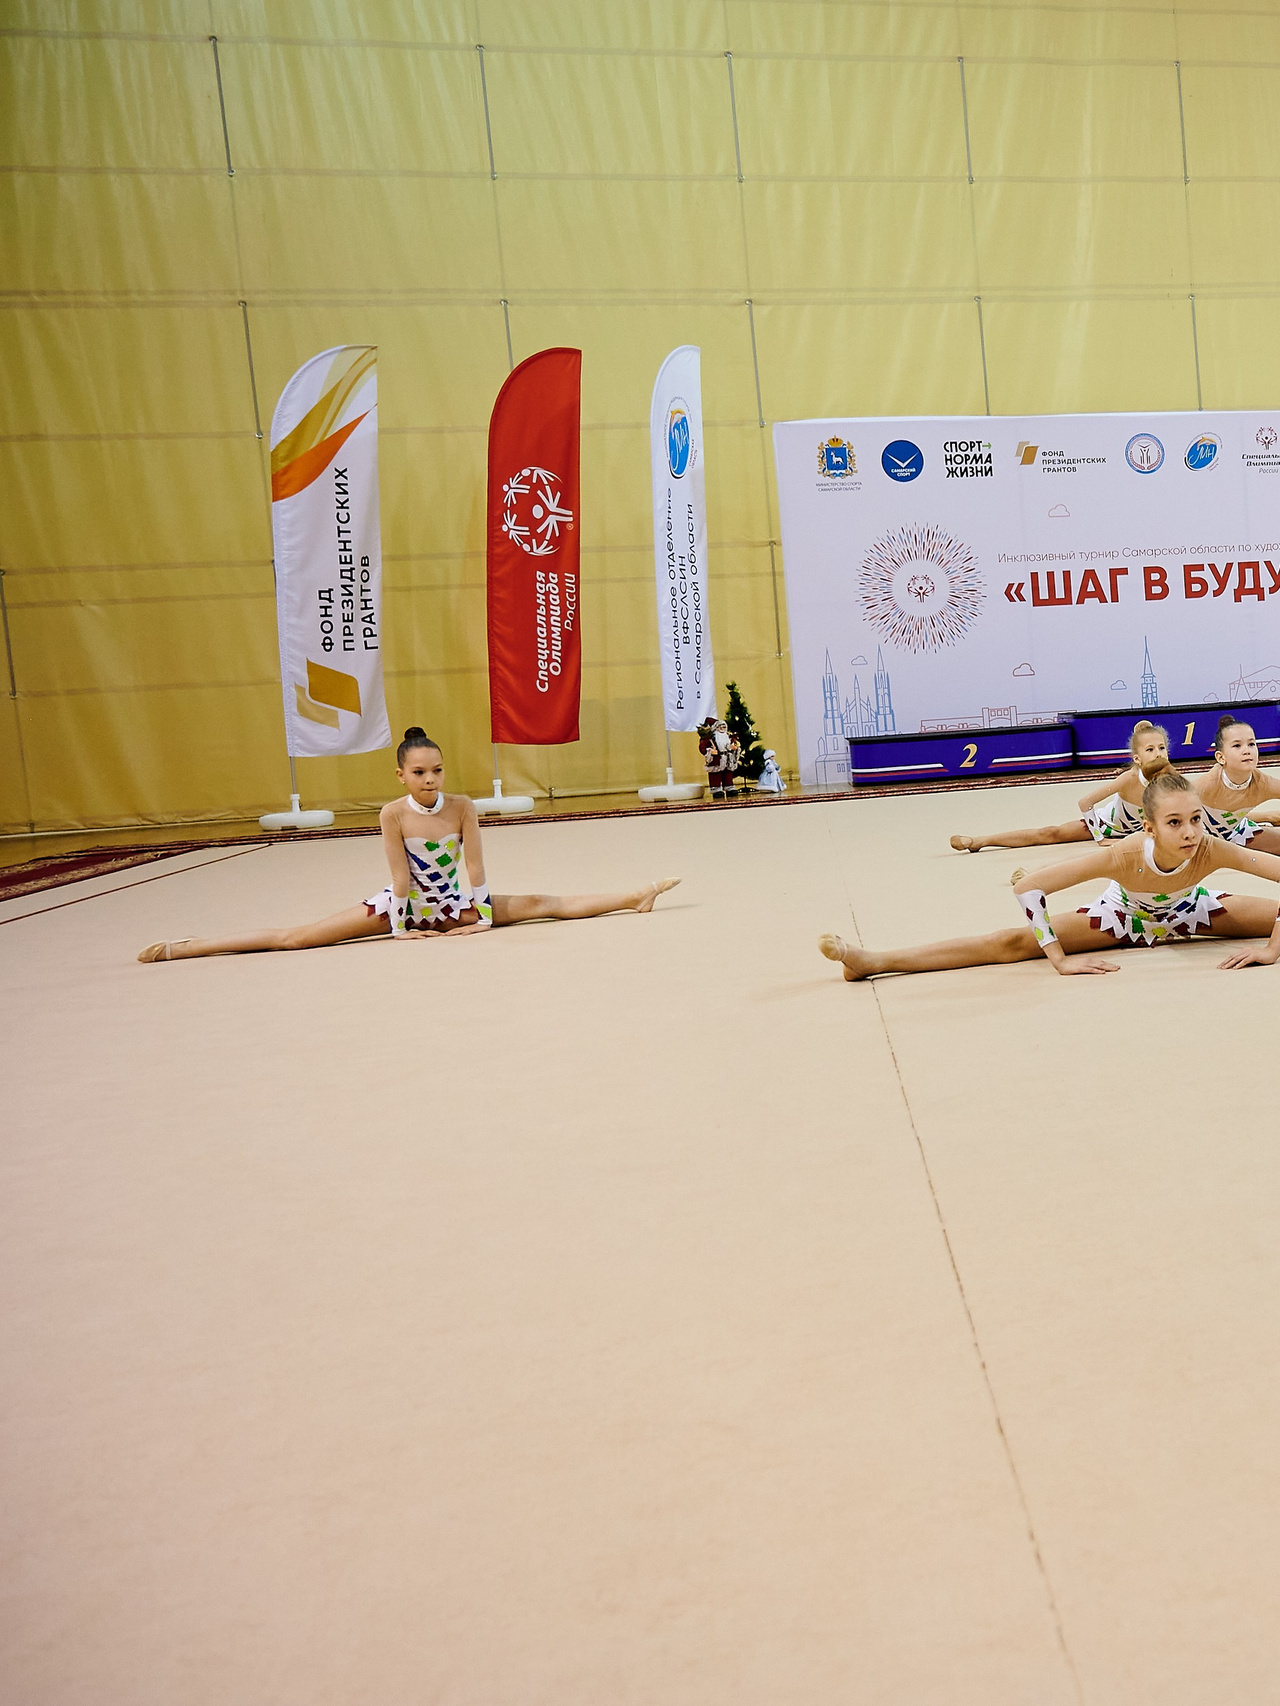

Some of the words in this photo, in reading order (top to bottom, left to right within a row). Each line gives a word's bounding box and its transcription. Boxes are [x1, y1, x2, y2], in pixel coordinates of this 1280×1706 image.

[944, 440, 982, 453] СПОРТ
[944, 453, 992, 466] НОРМА
[946, 466, 993, 478] ЖИЗНИ
[1041, 450, 1064, 458] ФОНД
[334, 467, 356, 652] ПРЕЗИДЕНТСКИХ
[666, 488, 677, 580] отделение
[687, 504, 698, 576] области
[998, 551, 1076, 563] Инклюзивный
[1079, 550, 1118, 562] турнир
[1122, 546, 1186, 558] Самарской
[1190, 544, 1234, 554] области
[1238, 544, 1252, 552] по
[360, 555, 378, 650] ГРАНТОВ
[564, 572, 576, 631] России
[678, 555, 690, 644] ВФСЛСИН
[1004, 568, 1128, 607] «ШАГ
[1143, 566, 1170, 602] В
[318, 588, 334, 652] ФОНД
[536, 570, 550, 692] Специальная
[546, 572, 562, 676] Олимпиада
[670, 587, 684, 710] Региональное
[690, 582, 702, 684] Самарской
[959, 743, 979, 768] 2
[1181, 722, 1196, 746] 1
